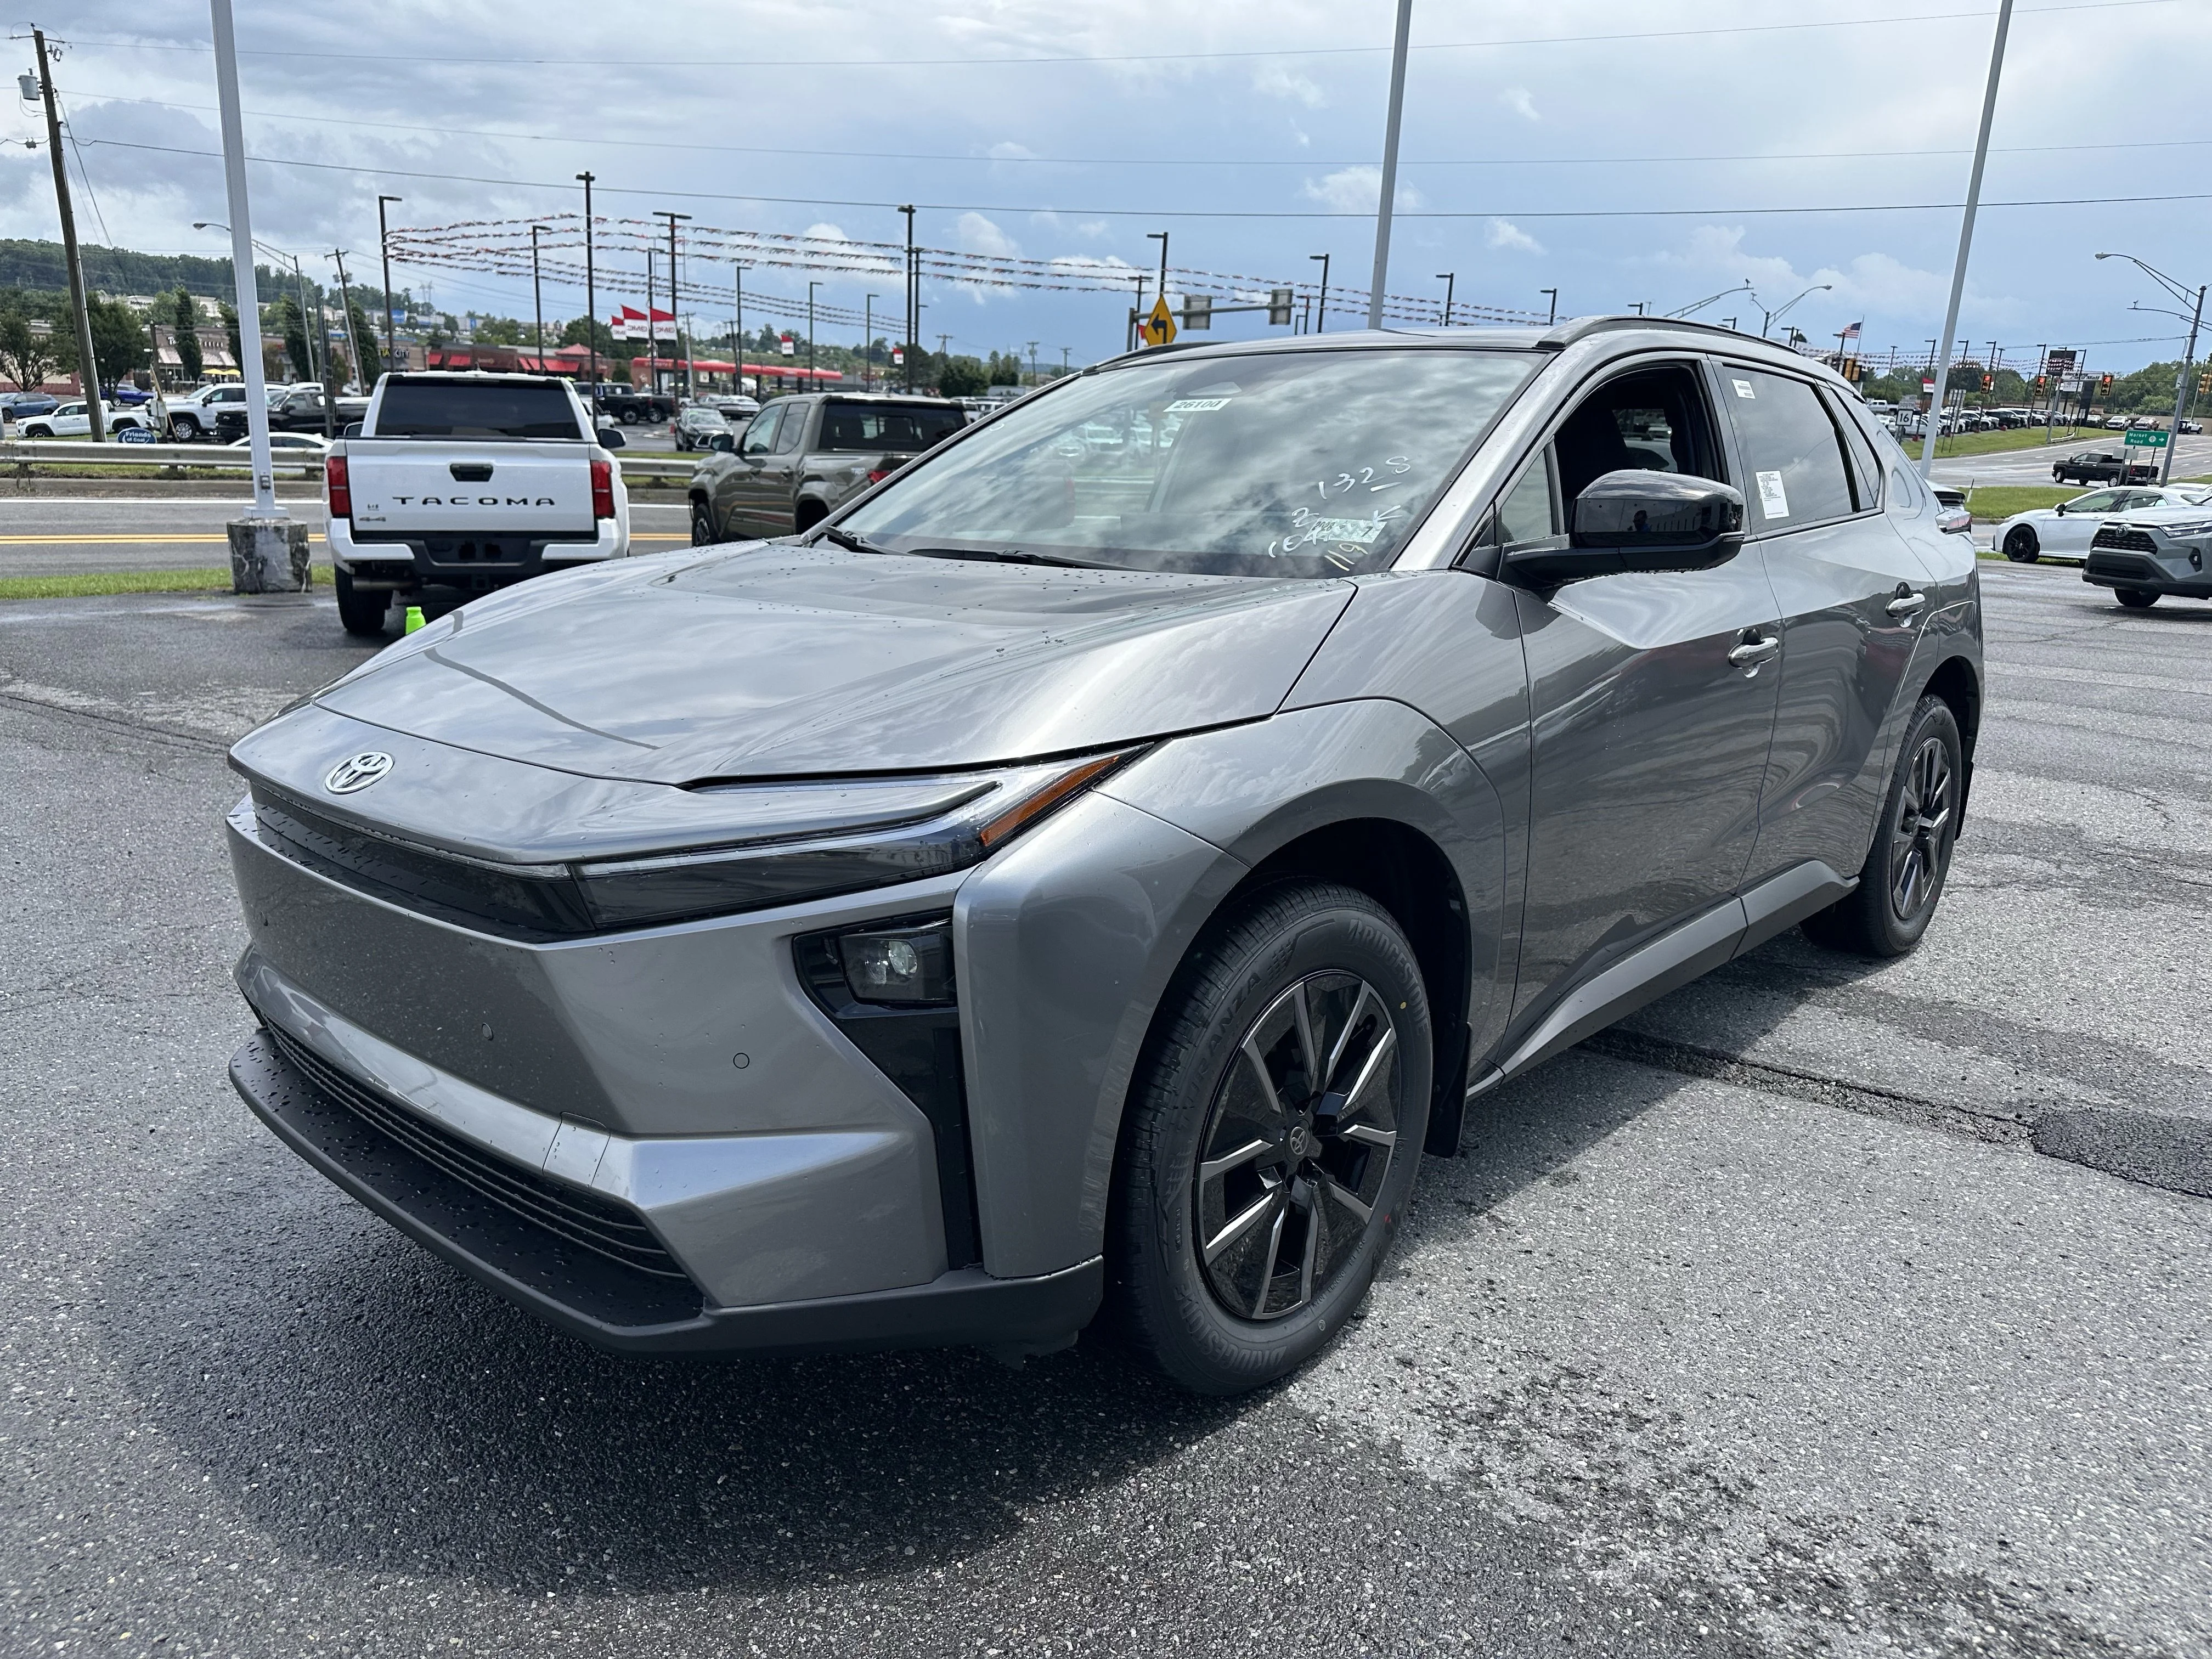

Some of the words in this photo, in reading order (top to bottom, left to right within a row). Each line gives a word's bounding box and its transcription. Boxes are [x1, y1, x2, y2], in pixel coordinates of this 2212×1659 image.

[1900, 413, 1909, 422] 16
[392, 496, 555, 506] TACOMA
[1347, 918, 1429, 1037] BRIDGESTONE
[1173, 1275, 1287, 1372] BRIDGESTONE
